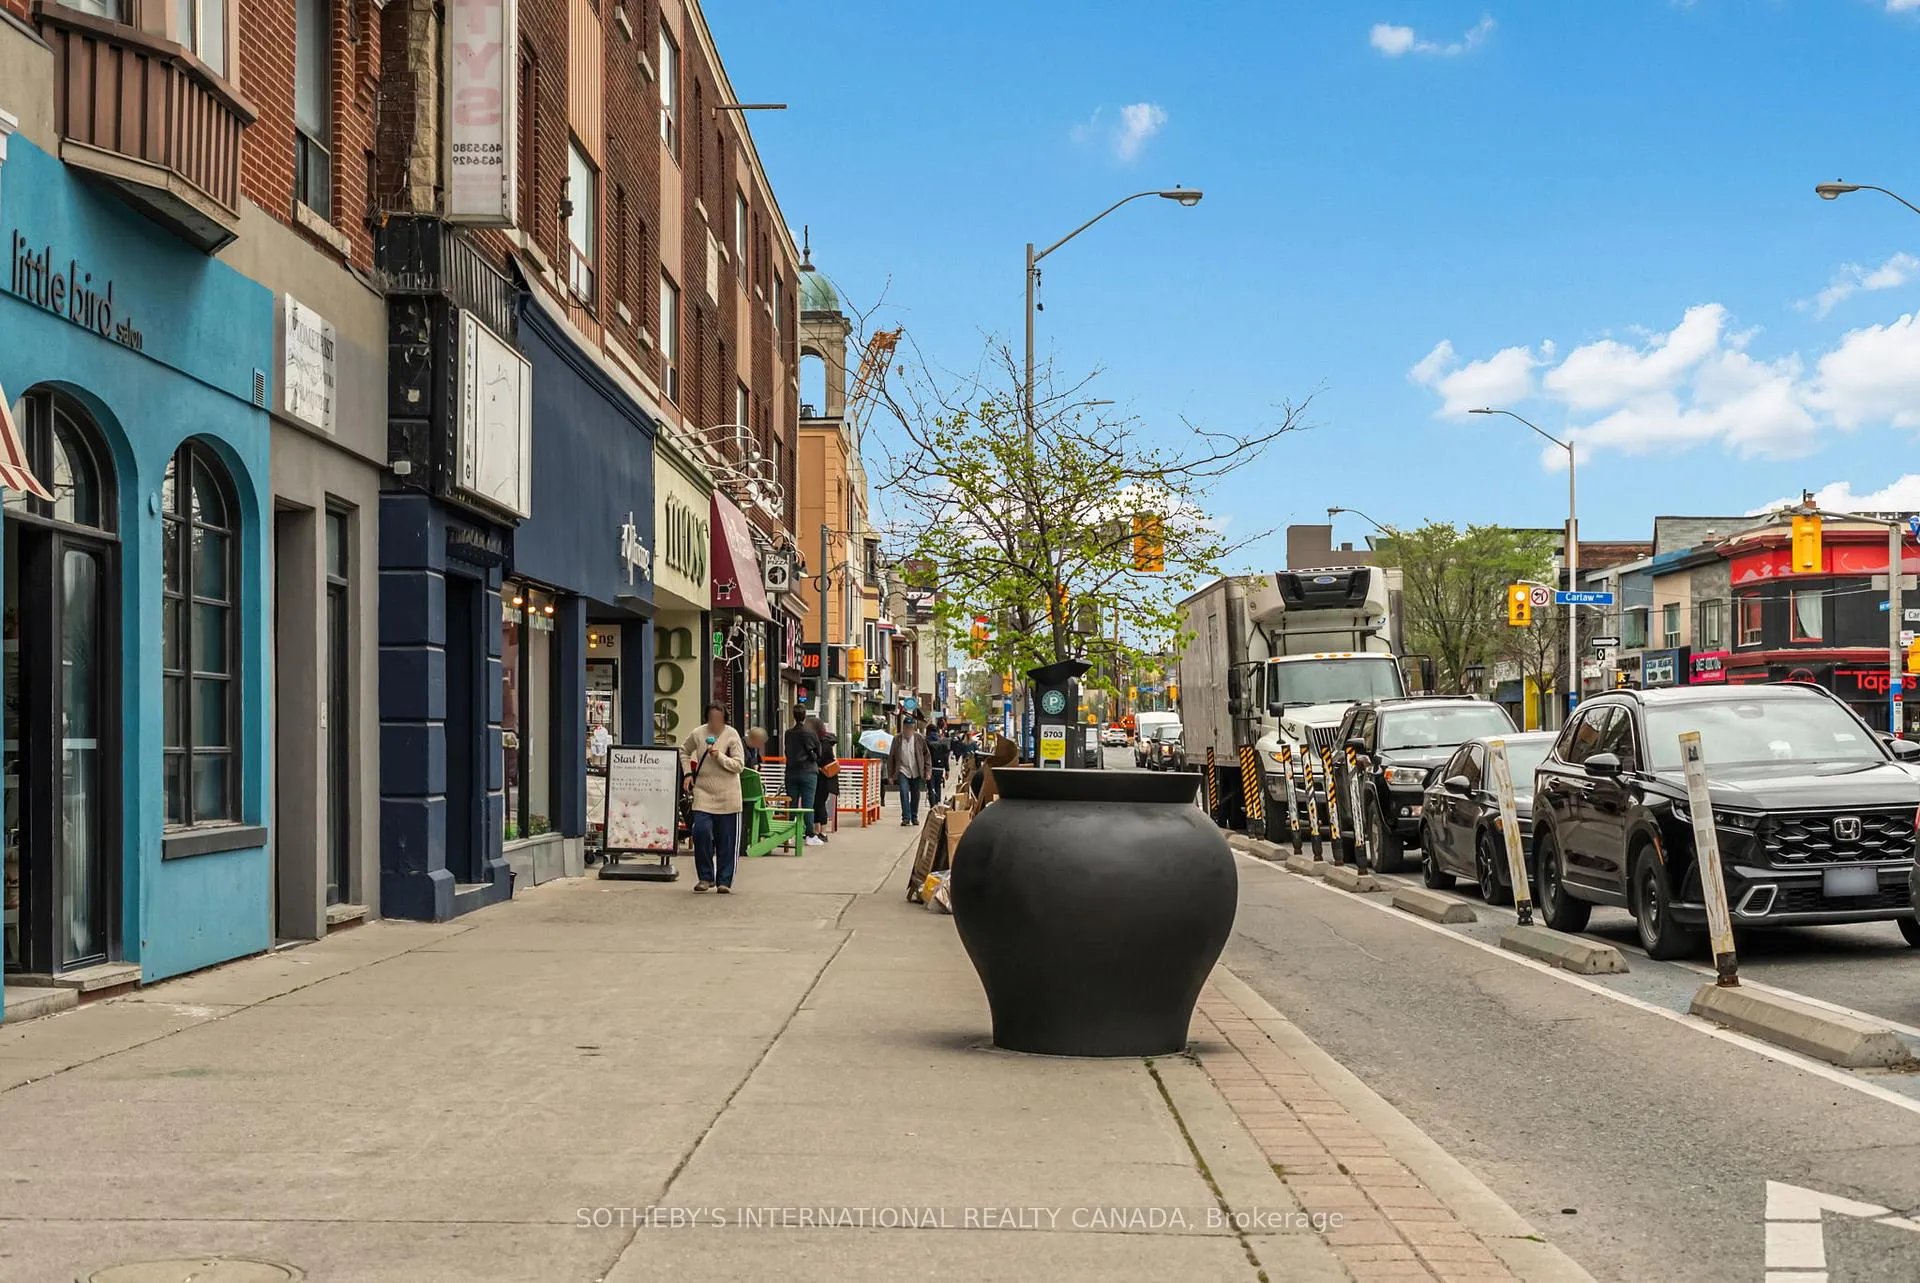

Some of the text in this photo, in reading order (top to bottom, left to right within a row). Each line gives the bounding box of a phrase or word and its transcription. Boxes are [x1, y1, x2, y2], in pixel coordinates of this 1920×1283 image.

[11, 228, 113, 338] little bird
[466, 322, 474, 481] CATERING
[665, 494, 709, 589] moss
[1565, 593, 1594, 602] Carlaw
[613, 753, 659, 765] Start Here
